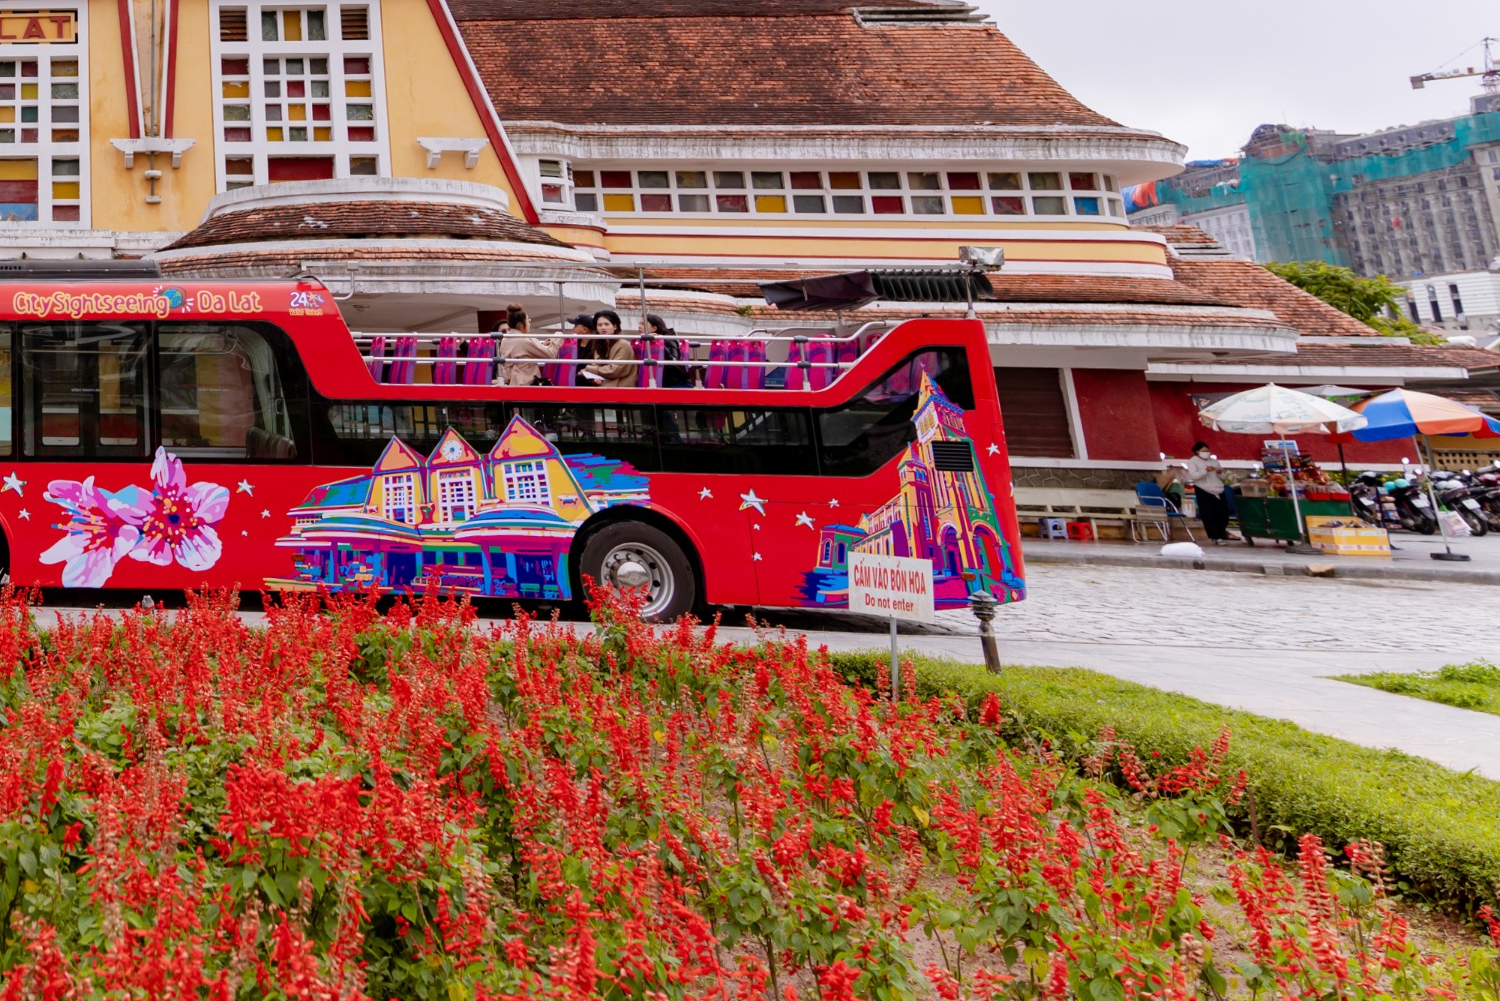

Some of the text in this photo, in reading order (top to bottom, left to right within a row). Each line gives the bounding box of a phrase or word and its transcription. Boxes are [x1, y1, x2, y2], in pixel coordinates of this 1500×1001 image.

[197, 290, 226, 313] Da
[229, 291, 263, 313] Lat
[854, 557, 871, 588] CẤM
[872, 562, 888, 591] VÀO
[909, 570, 926, 595] HOA
[865, 593, 914, 613] Do not enter
